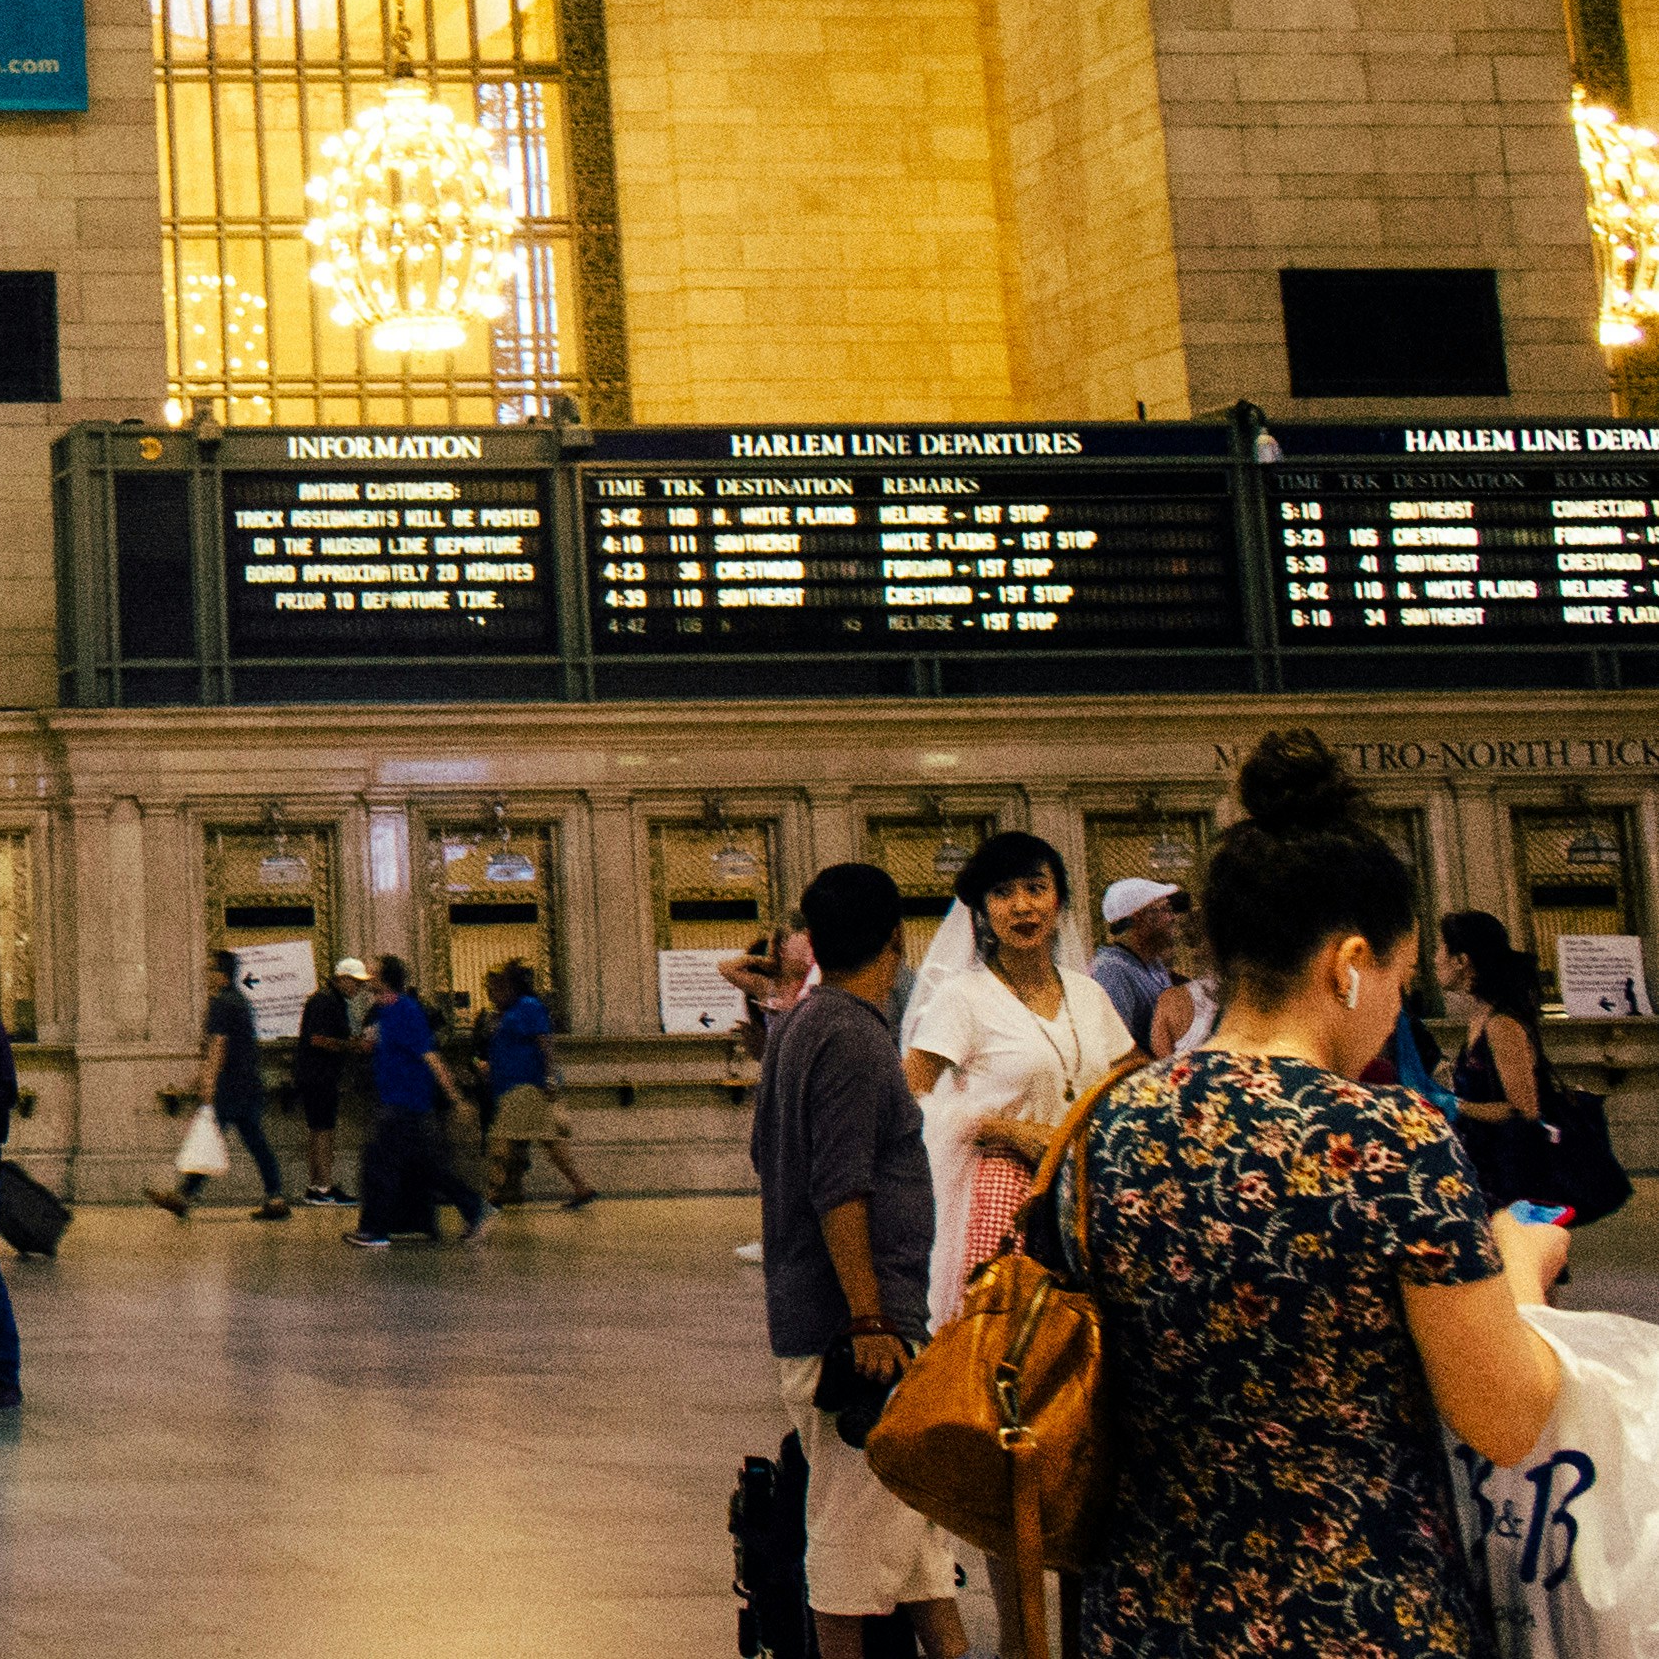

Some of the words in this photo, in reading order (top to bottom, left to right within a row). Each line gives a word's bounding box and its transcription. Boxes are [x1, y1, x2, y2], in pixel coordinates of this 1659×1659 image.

[288, 436, 481, 459] INFORMATION
[731, 435, 844, 456] HARLEM
[851, 434, 911, 455] LINE
[919, 433, 1082, 455] DEPARTURES
[1405, 429, 1516, 452] HARLEM
[1521, 429, 1582, 451] LINE
[597, 479, 646, 496] TIME
[660, 479, 704, 496] TRK
[716, 478, 854, 495] DESTINATION
[883, 477, 980, 494] REMARKS
[1278, 473, 1322, 489] TIME
[1341, 473, 1381, 489] TRK
[1392, 473, 1525, 489] DESTINATION
[1556, 472, 1649, 488] REMARKS
[299, 483, 359, 500] AMTRAK
[366, 483, 460, 500] CUSTOMERS:
[600, 508, 642, 526] 3:42
[712, 508, 732, 525] N.
[740, 507, 791, 524] WHITE
[796, 507, 856, 524] PLAINS
[879, 505, 949, 523] MELROSE
[974, 506, 1002, 522] 1ST
[1008, 505, 1050, 522] STOP
[1280, 502, 1322, 520] 5:10
[1389, 501, 1474, 519] SOUTHEAST
[1551, 500, 1647, 518] CONNECTION
[235, 511, 284, 528] TRACK
[291, 510, 399, 527] ASSIGNMENTS
[405, 510, 445, 527] WILL
[452, 510, 474, 527] BE
[480, 510, 540, 527] POSTED
[601, 535, 644, 553] 4:10
[670, 534, 697, 553] 111
[713, 534, 801, 552] SOUTHEAST
[881, 533, 932, 551] WHITE
[937, 533, 996, 550] PLAINS
[1022, 532, 1050, 550] 1ST
[1056, 531, 1097, 549] STOP
[1283, 529, 1325, 547] 5:23
[1392, 527, 1479, 546] CRESTWOOD
[1554, 526, 1623, 545] FORDHAM
[254, 538, 275, 555] ON
[283, 538, 313, 555] THE
[321, 538, 380, 554] HUDSON
[389, 538, 427, 554] LINE
[434, 537, 523, 554] DEPARTURE
[603, 562, 646, 580] 4:23
[715, 560, 805, 579] CRESTWOOD
[883, 560, 952, 578] FORDHAM
[978, 559, 1006, 577] 1ST
[1013, 558, 1054, 576] STOP
[1286, 556, 1327, 574] 5:39
[1359, 555, 1379, 573] 41
[1394, 554, 1480, 572] SOUTHEAST
[1557, 553, 1643, 572] CRESTWOOD
[245, 565, 296, 582] BOARD
[303, 565, 429, 582] APPROXIMATELY
[437, 565, 458, 581] 20
[465, 563, 534, 580] MINUTES
[717, 588, 805, 607] SOUTHEAST
[885, 586, 973, 605] CRESTWOOD
[998, 585, 1027, 603] 1ST
[1033, 585, 1074, 603] STOP
[1288, 582, 1330, 601] 5:42
[1397, 581, 1417, 599] N.
[1425, 581, 1475, 599] WHITE
[1479, 580, 1538, 598] PLAINS
[1560, 580, 1630, 598] MELROSE
[276, 593, 326, 609] PRIOR
[334, 593, 354, 609] TO
[362, 592, 449, 609] DEPARTURE
[457, 591, 503, 608] TIME.
[605, 589, 647, 608] 4:39
[888, 614, 954, 630] MELROSE
[982, 612, 1010, 630] 1ST
[1017, 612, 1058, 630] STOP
[1291, 609, 1333, 627] 6:10
[1364, 608, 1387, 626] 34
[1400, 607, 1485, 626] SOUTHEAST
[1563, 606, 1613, 624] WHITE
[1333, 739, 1569, 770] TRO-NORTH
